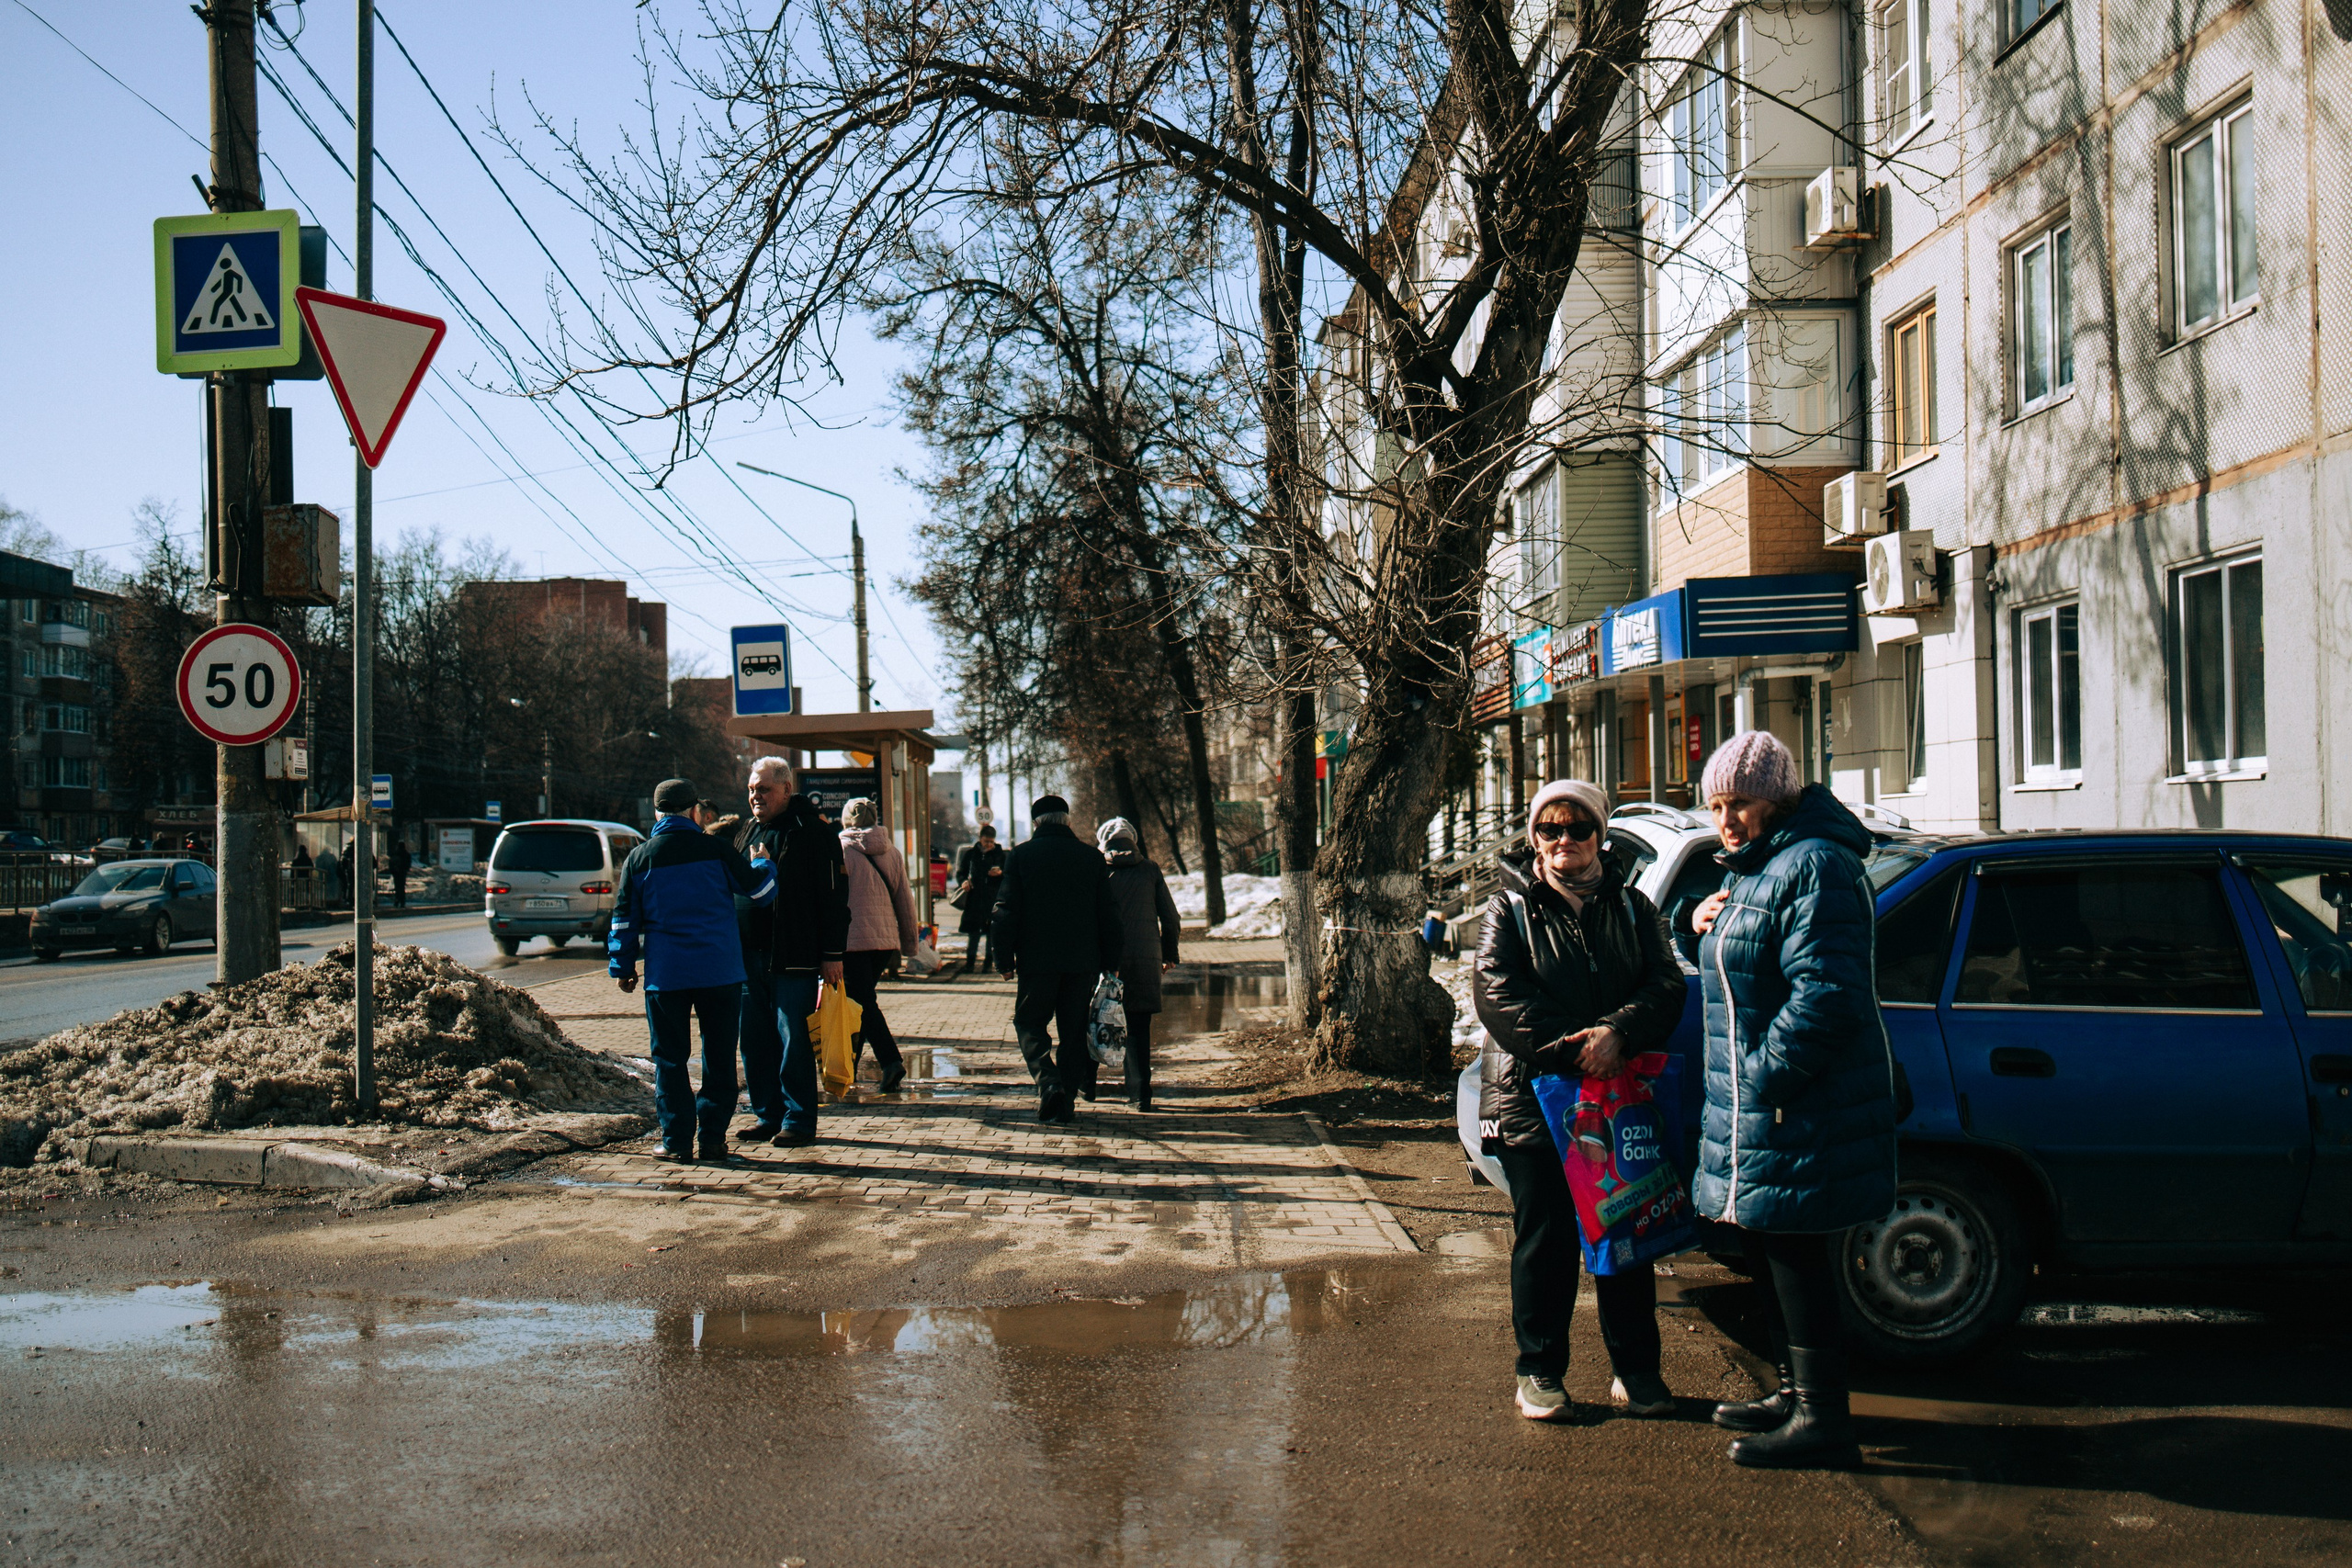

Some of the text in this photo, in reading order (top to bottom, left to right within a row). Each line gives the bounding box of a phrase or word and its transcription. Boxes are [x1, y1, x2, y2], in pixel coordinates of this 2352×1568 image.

[205, 662, 275, 709] 50
[822, 792, 850, 800] CONCORD
[159, 810, 197, 818] ХЛЕБ
[978, 812, 990, 820] 50
[1623, 1142, 1661, 1161] банк
[1602, 1184, 1651, 1218] товары
[1635, 1186, 1686, 1229] на OZON
